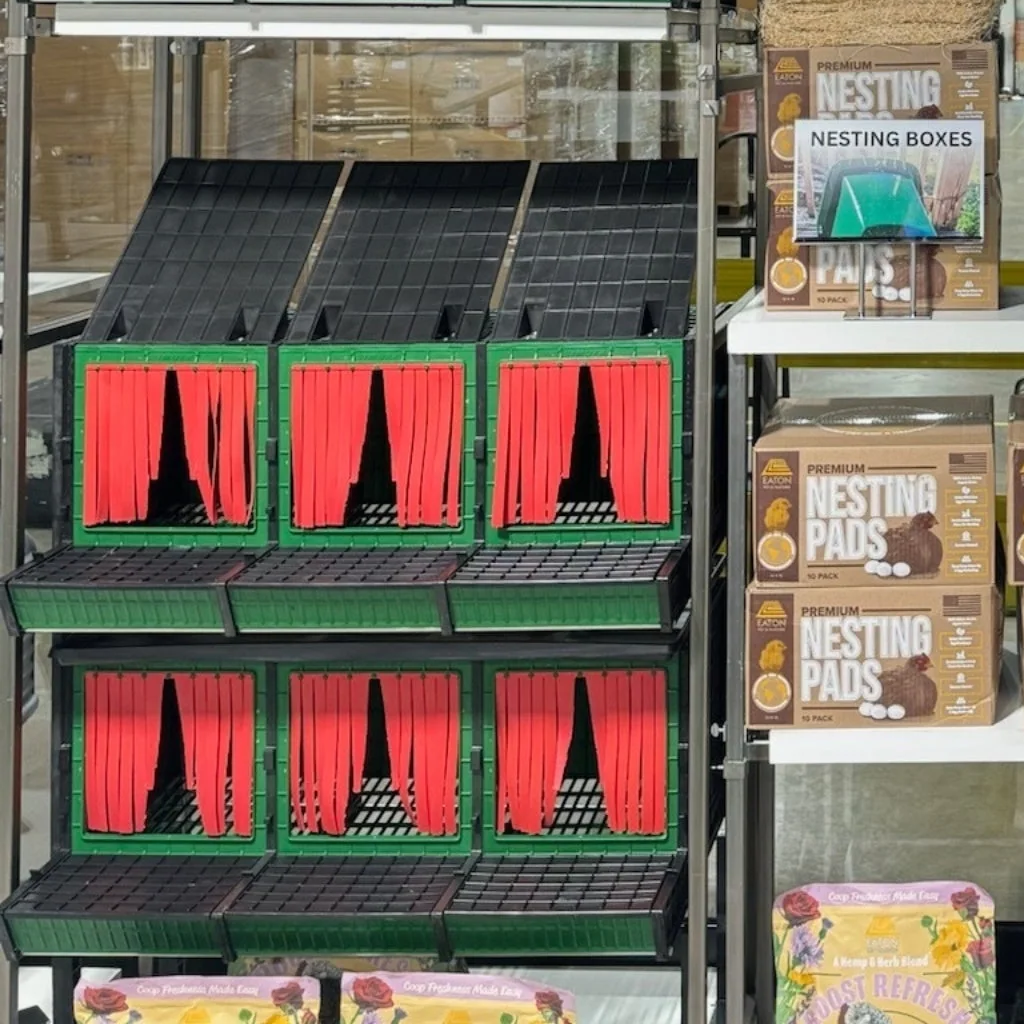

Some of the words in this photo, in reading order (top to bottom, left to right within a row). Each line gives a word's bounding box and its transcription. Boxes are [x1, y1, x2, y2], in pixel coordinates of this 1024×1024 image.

[817, 61, 872, 71] PREMIUM
[816, 70, 941, 112] NESTING
[811, 131, 900, 147] NESTING
[906, 131, 972, 147] BOXES
[816, 244, 895, 285] PADS
[807, 464, 865, 474] PREMIUM
[762, 476, 792, 484] EATON
[806, 474, 938, 518] NESTING
[806, 517, 888, 561] PADS
[801, 606, 859, 616] PREMIUM
[800, 615, 932, 659] NESTING
[800, 658, 882, 702] PADS
[828, 891, 848, 902] Coop
[892, 891, 917, 901] Made
[918, 890, 939, 901] Easy
[832, 957, 839, 968] A
[840, 956, 868, 969] Hemp
[877, 956, 899, 967] Herb
[900, 955, 928, 967] Blend
[136, 985, 159, 996] Coop
[162, 985, 207, 996] Freshness
[208, 985, 235, 996] Made
[236, 985, 259, 997] Easy
[402, 981, 426, 992] Coop
[427, 982, 471, 994] Freshness
[472, 984, 498, 995] Made
[500, 986, 523, 998] Easy
